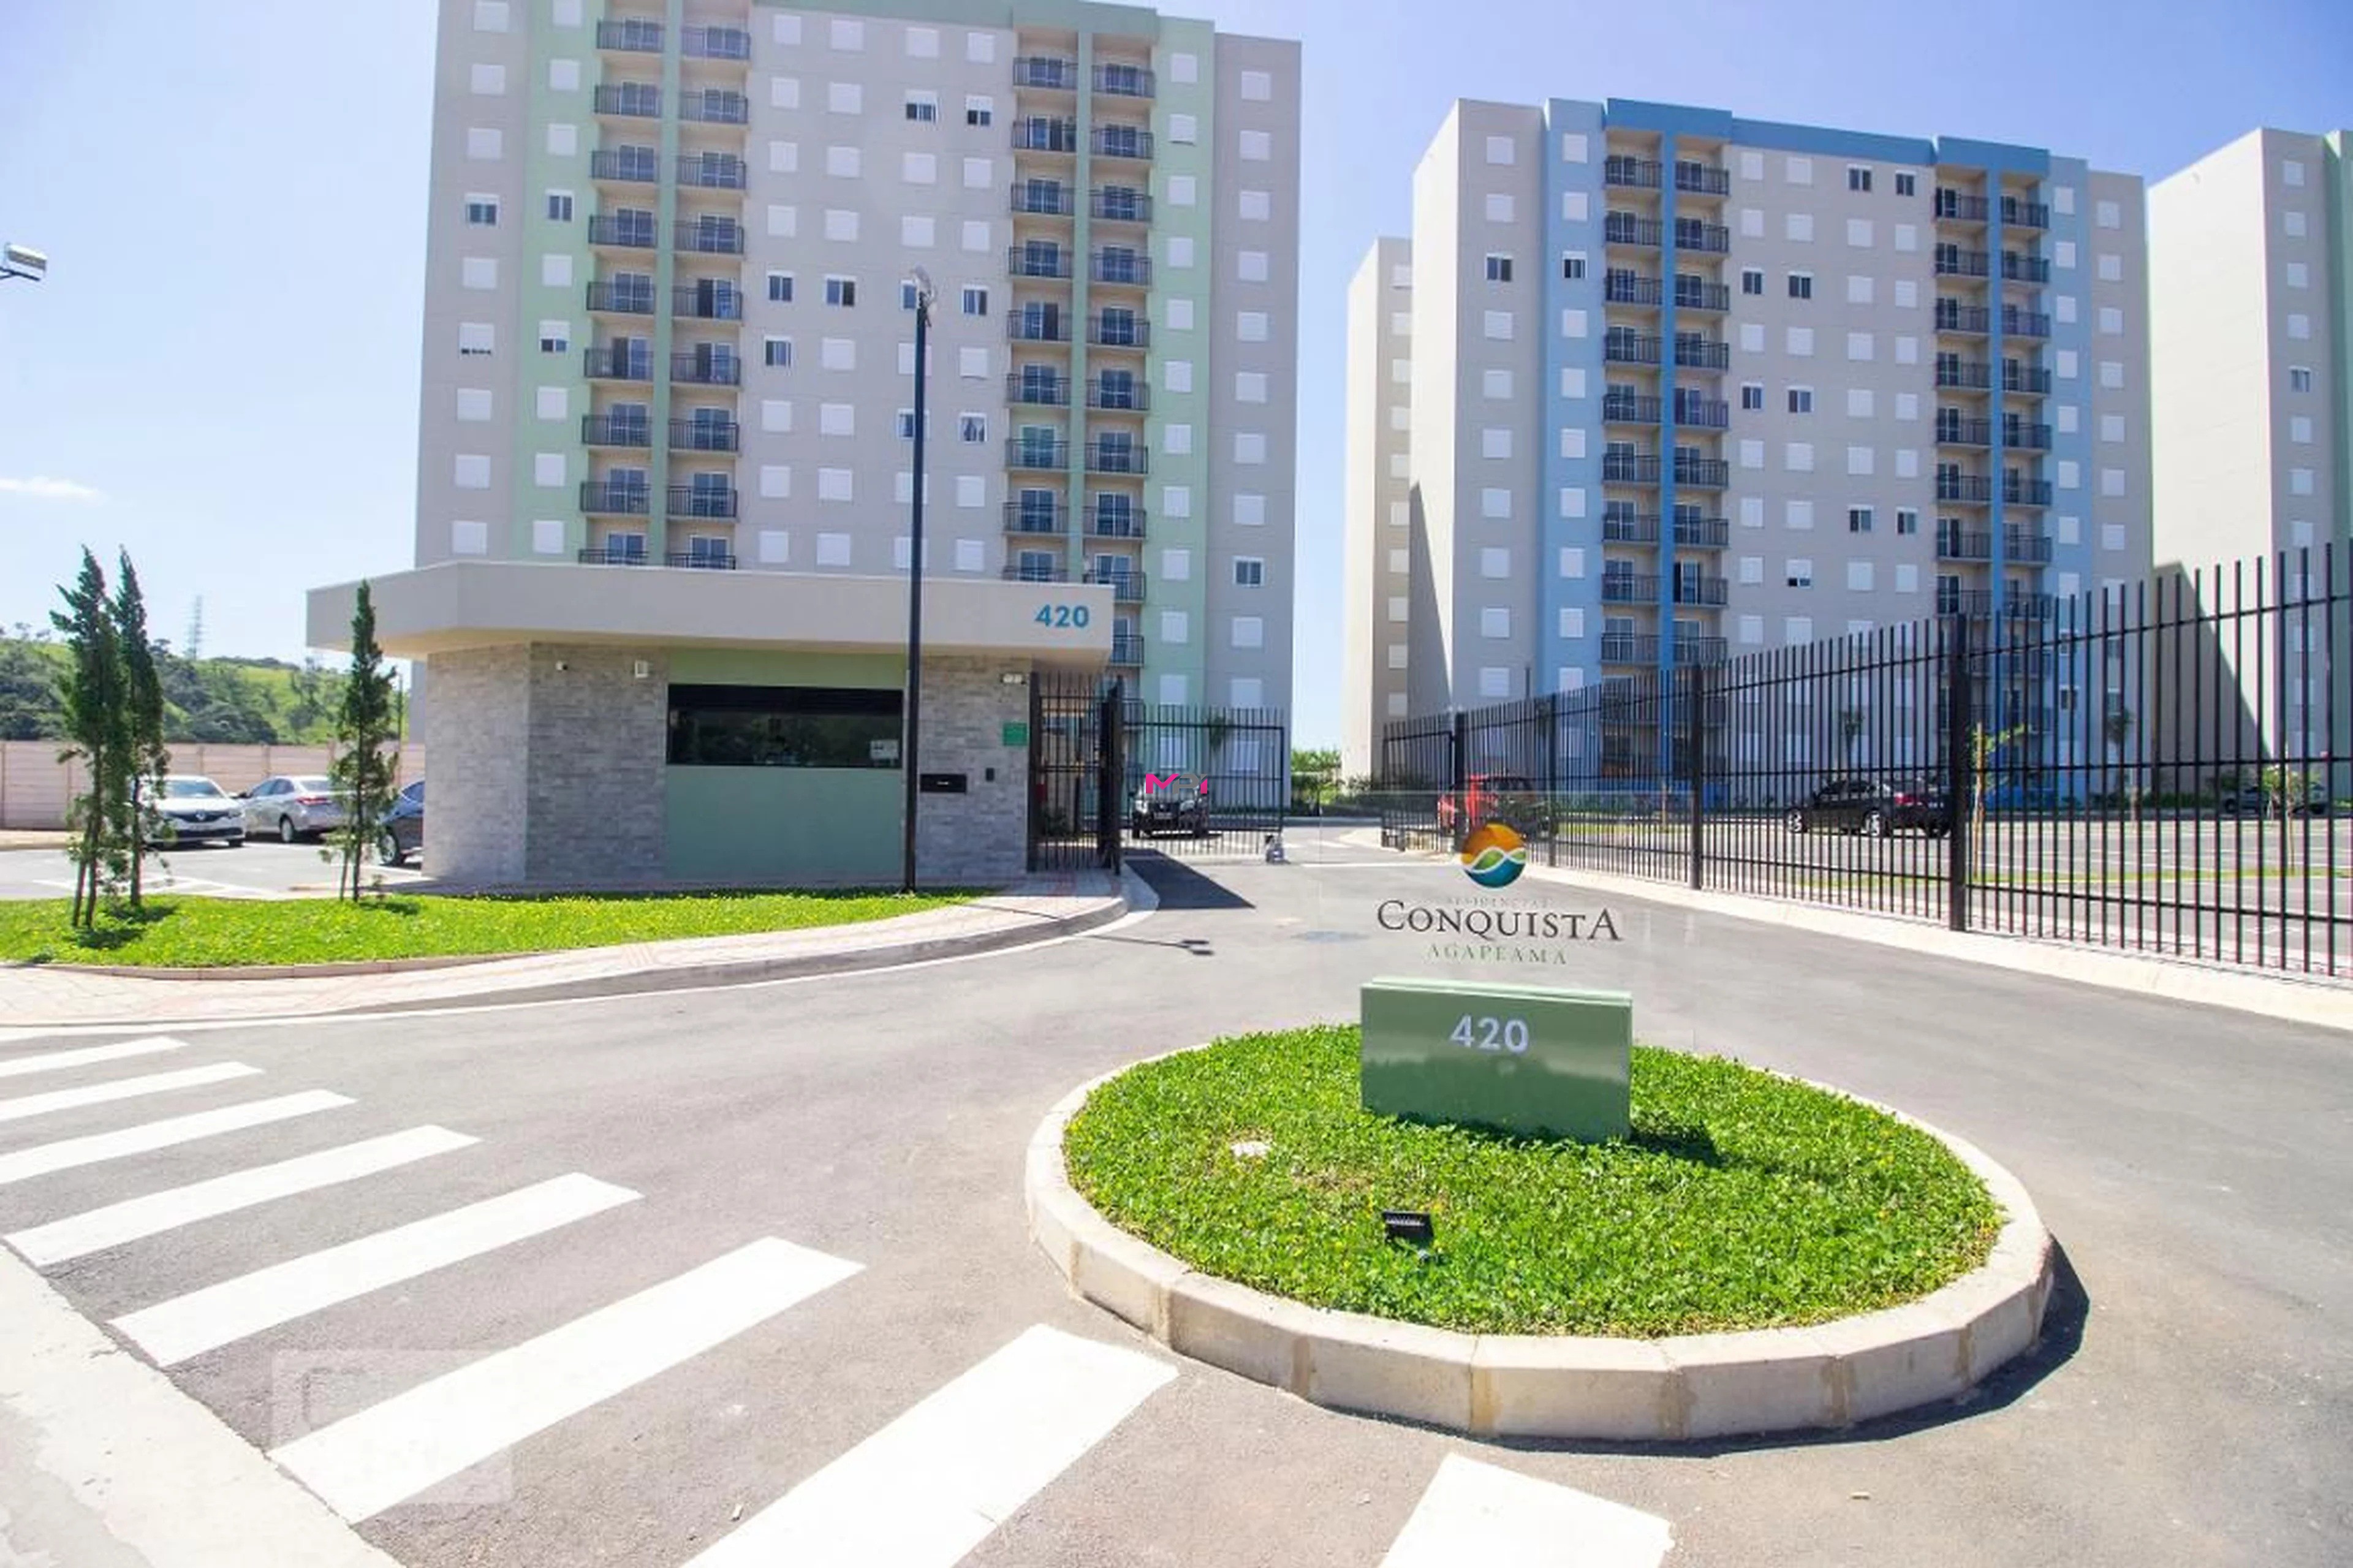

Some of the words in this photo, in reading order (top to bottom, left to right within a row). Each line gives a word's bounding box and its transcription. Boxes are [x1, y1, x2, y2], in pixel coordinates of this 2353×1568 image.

[1035, 604, 1089, 628] 420
[1377, 900, 1623, 942] CONQUISTA
[1426, 944, 1567, 965] AGAPEAMA
[1450, 1014, 1529, 1053] 420
